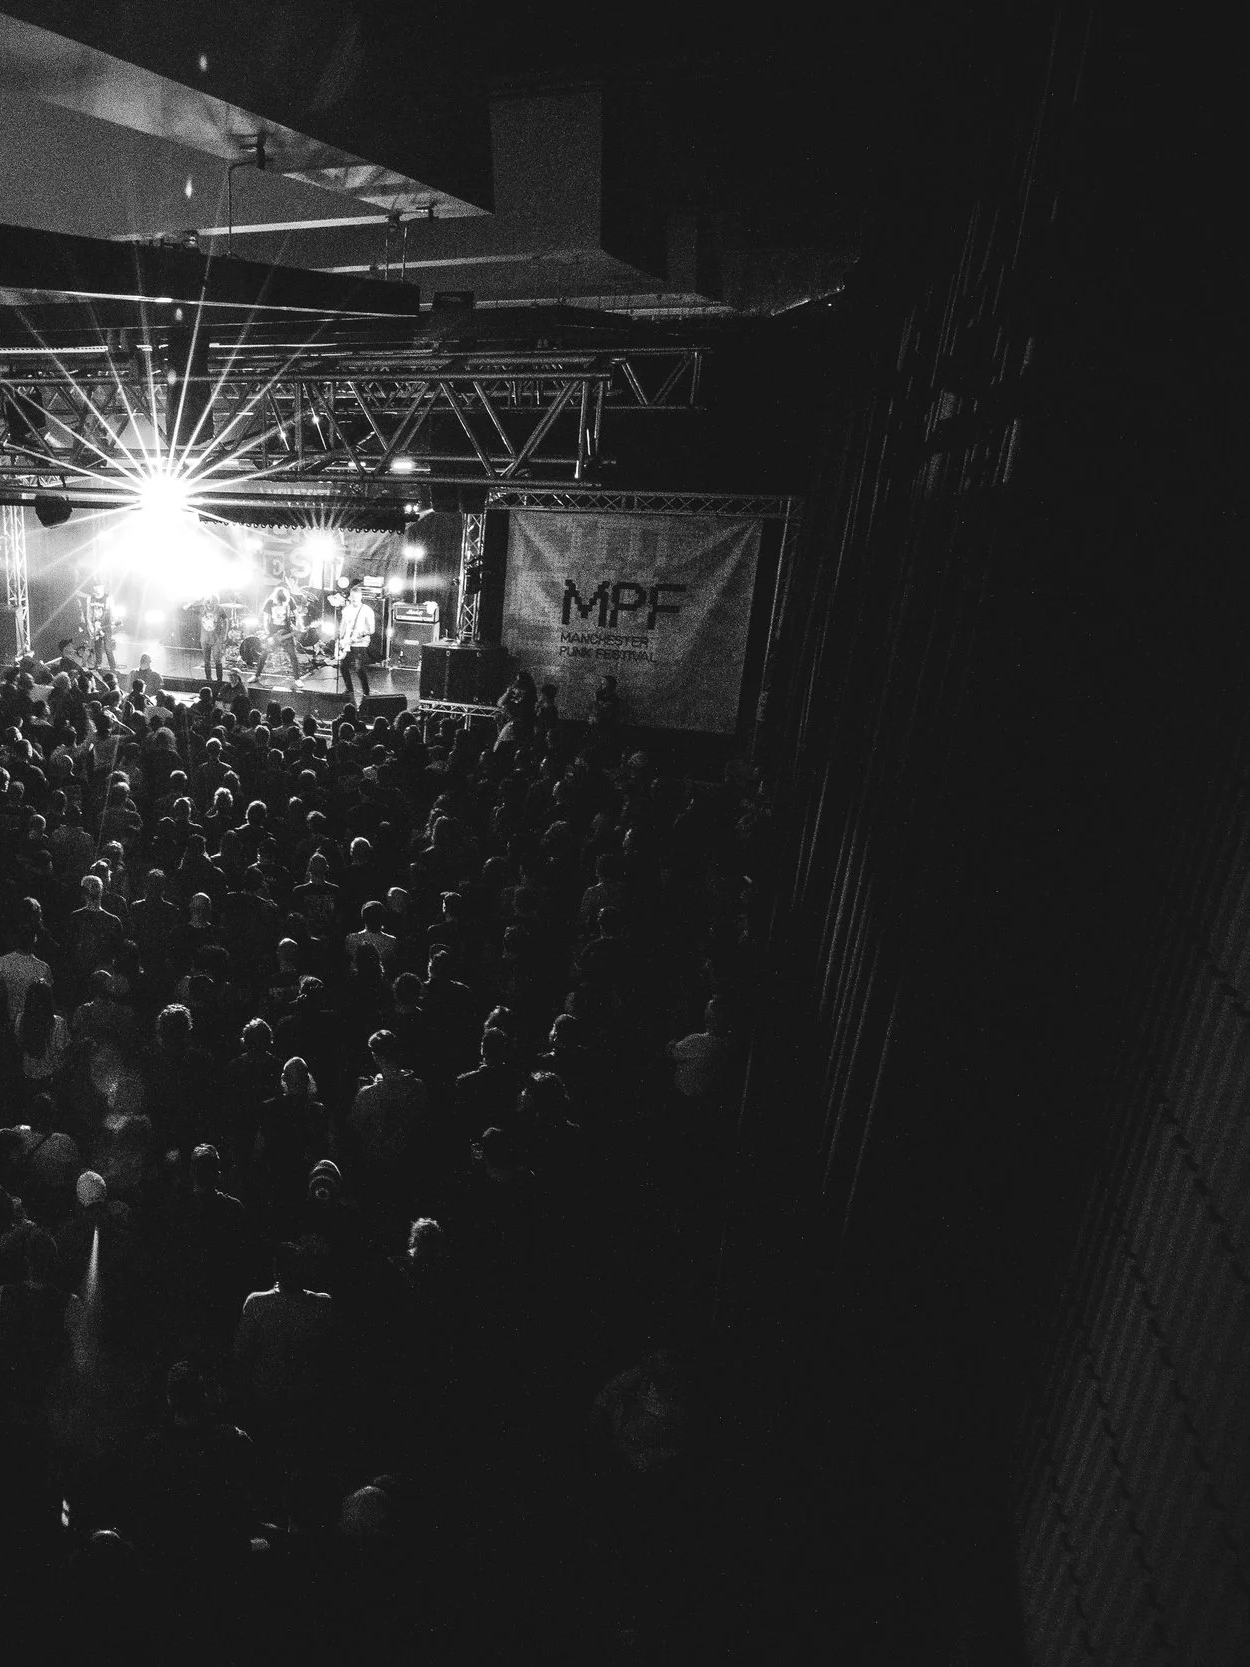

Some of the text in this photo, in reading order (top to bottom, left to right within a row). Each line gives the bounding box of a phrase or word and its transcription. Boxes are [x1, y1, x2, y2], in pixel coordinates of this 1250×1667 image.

[562, 579, 686, 630] MPF
[560, 632, 649, 647] MANCHESTER
[559, 646, 657, 663] PUNK FESTIVAL
